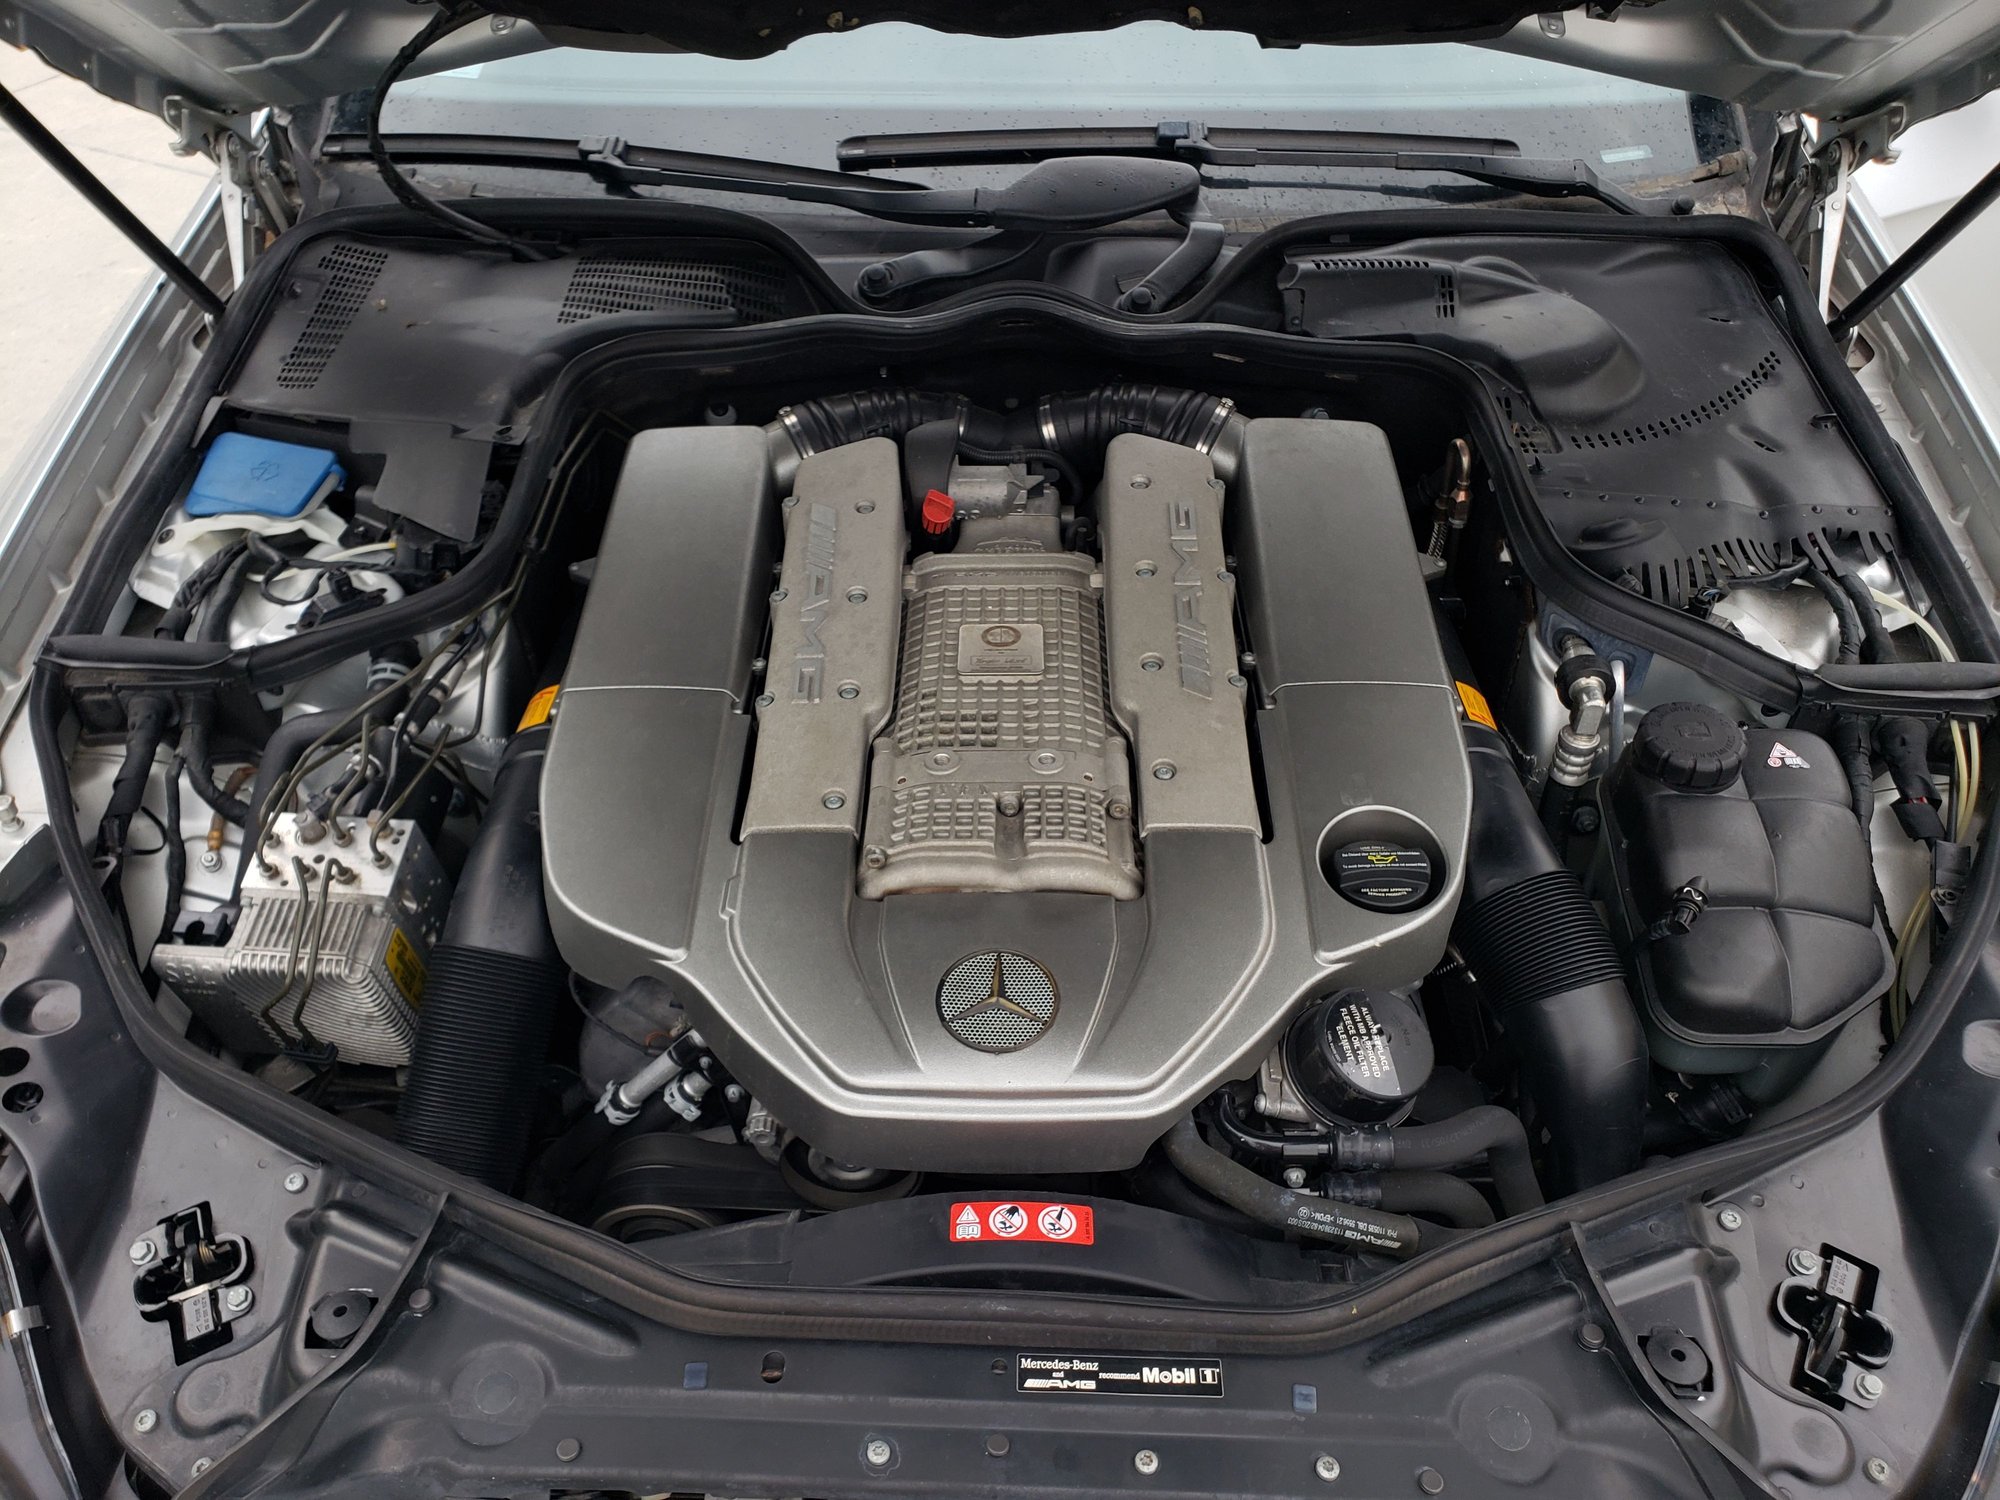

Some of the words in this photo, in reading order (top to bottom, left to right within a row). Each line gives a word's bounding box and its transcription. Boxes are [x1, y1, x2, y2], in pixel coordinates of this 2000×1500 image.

[792, 503, 836, 704] AMG
[1169, 501, 1213, 700] AMG
[1340, 1008, 1356, 1036] FLEECE
[1336, 1025, 1354, 1061] ELEMENT
[1350, 1004, 1362, 1022] WITH
[1357, 1022, 1366, 1034] MB
[1362, 1036, 1380, 1078] APPROVED
[1352, 1036, 1361, 1050] OIL
[1361, 1006, 1378, 1034] ALWAYS
[1372, 1034, 1390, 1072] REPLACE
[1356, 1050, 1370, 1078] FILTER
[1344, 1229, 1402, 1248] AMG
[1020, 1358, 1098, 1370] Mercedes-Benz
[1024, 1378, 1096, 1390] AMG
[1098, 1372, 1140, 1380] recommend
[1142, 1366, 1196, 1384] Mobil
